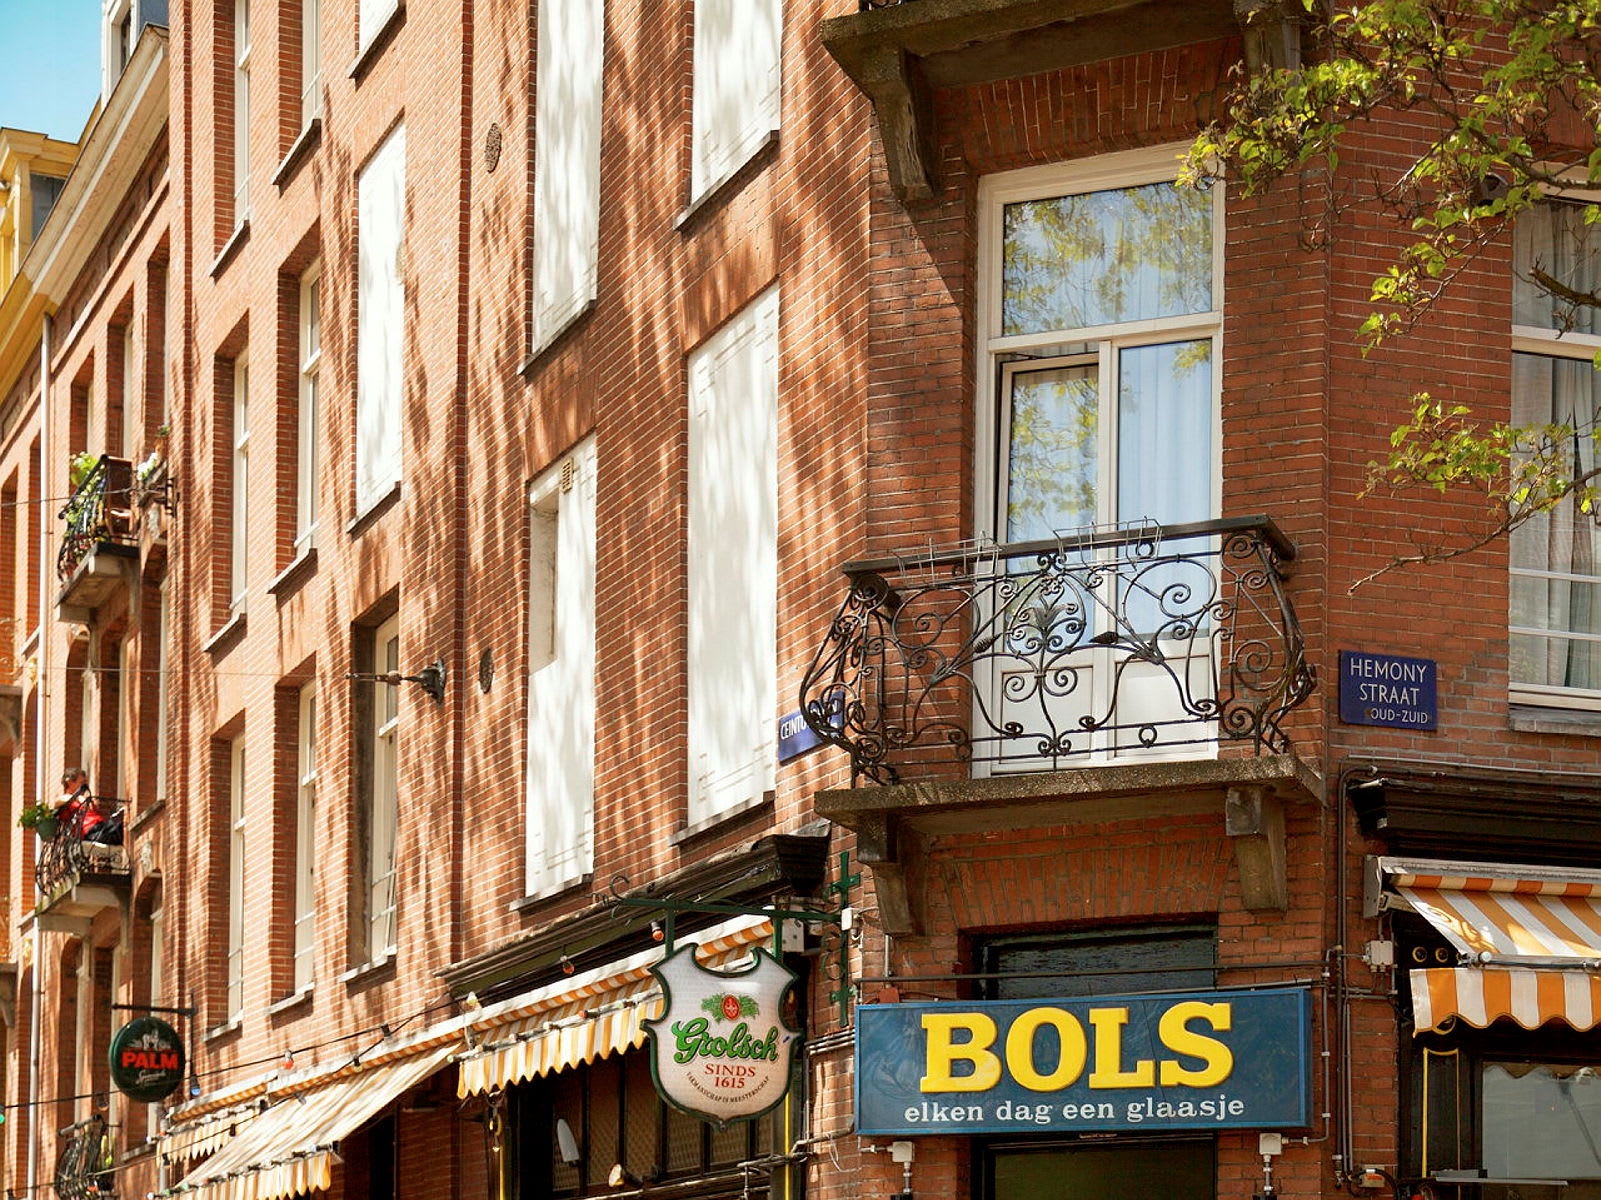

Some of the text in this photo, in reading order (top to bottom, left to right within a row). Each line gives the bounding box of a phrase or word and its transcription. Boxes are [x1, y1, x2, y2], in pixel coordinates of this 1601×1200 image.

[1350, 657, 1427, 683] HEMONY
[1360, 683, 1420, 706] STRAAT
[1370, 707, 1429, 724] OUD-ZUID
[671, 1016, 780, 1064] Grolsch
[919, 1001, 1235, 1093] BOLS
[121, 1051, 179, 1070] PALM
[704, 1063, 757, 1077] SINDS
[714, 1076, 746, 1089] 1615
[904, 1097, 1245, 1125] elken dag een glaasje
